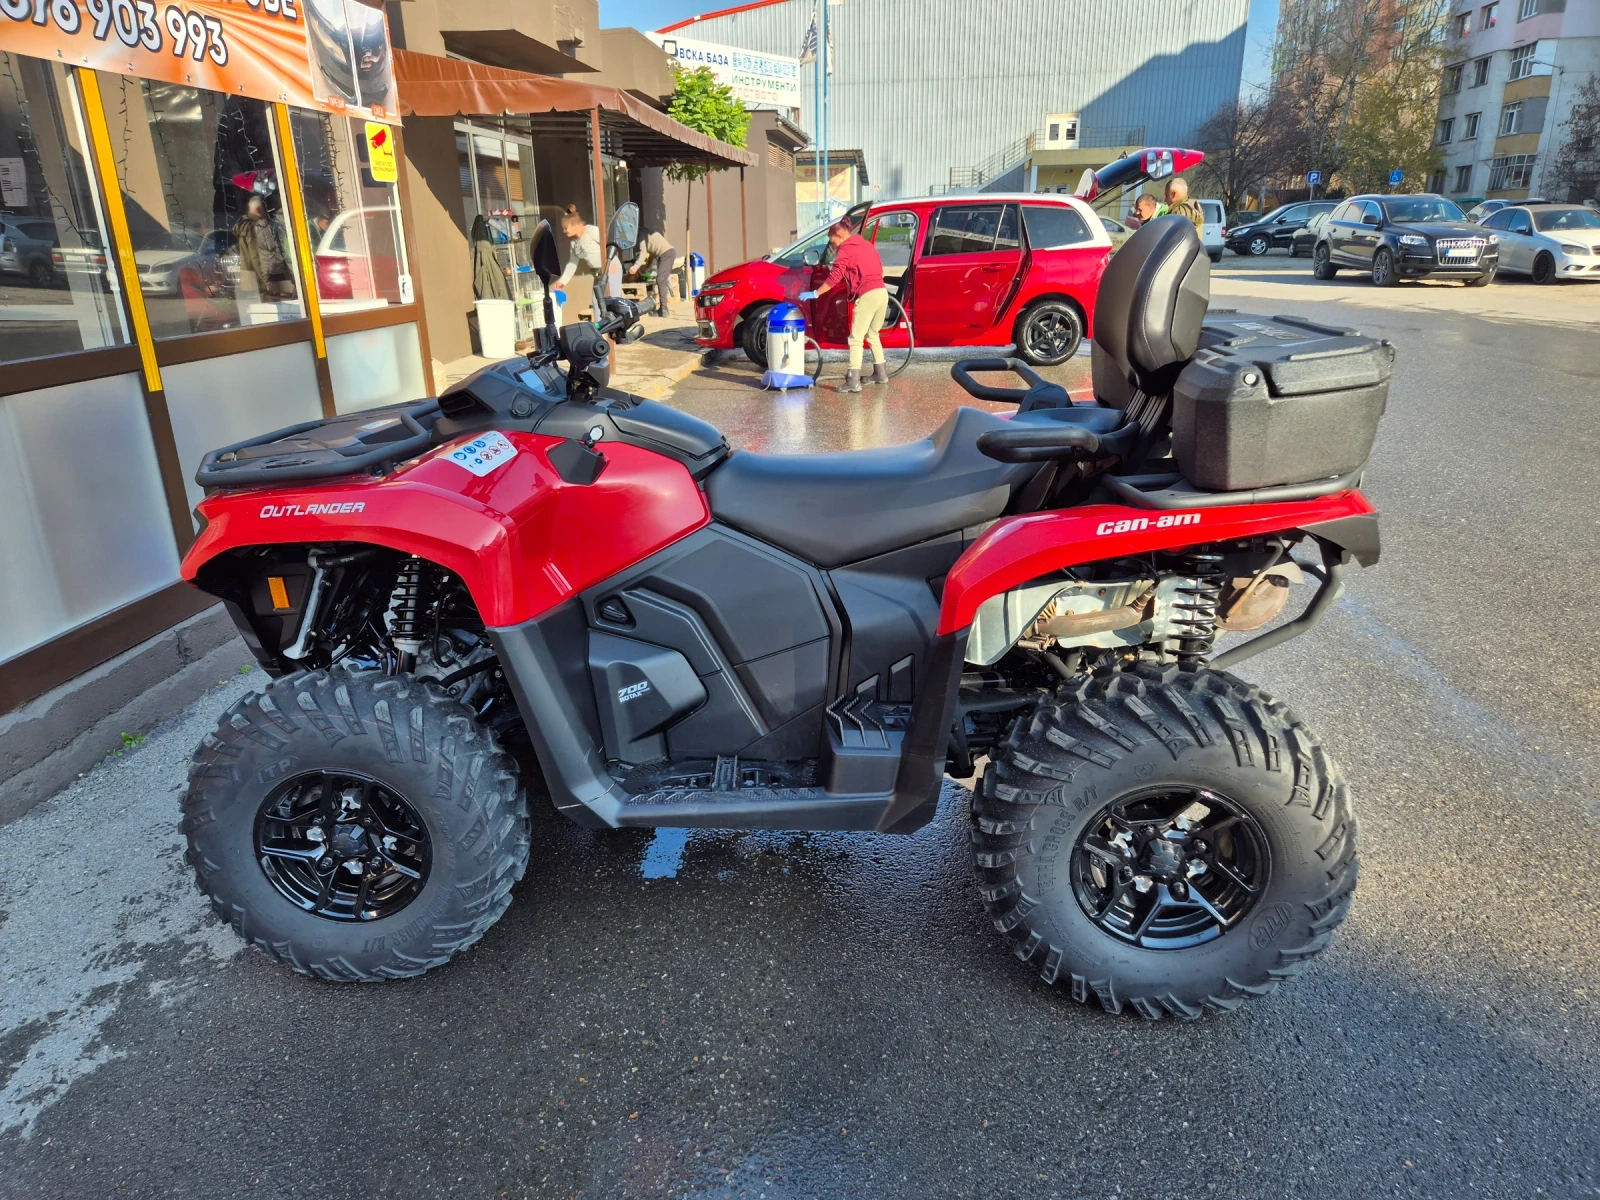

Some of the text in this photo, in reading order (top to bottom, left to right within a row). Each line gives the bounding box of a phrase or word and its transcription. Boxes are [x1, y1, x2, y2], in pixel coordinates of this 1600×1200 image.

[86, 0, 162, 52] 903
[165, 5, 229, 67] 993
[706, 53, 729, 66] БАЗА
[732, 75, 797, 93] ИНСТРУМЕНТИ
[1310, 173, 1317, 182] P
[260, 502, 365, 518] OUTLANDER
[1096, 513, 1201, 535] can-am
[618, 681, 648, 697] 700
[619, 691, 643, 703] ROTAX
[257, 759, 291, 784] ITP
[1073, 785, 1098, 812] R/T
